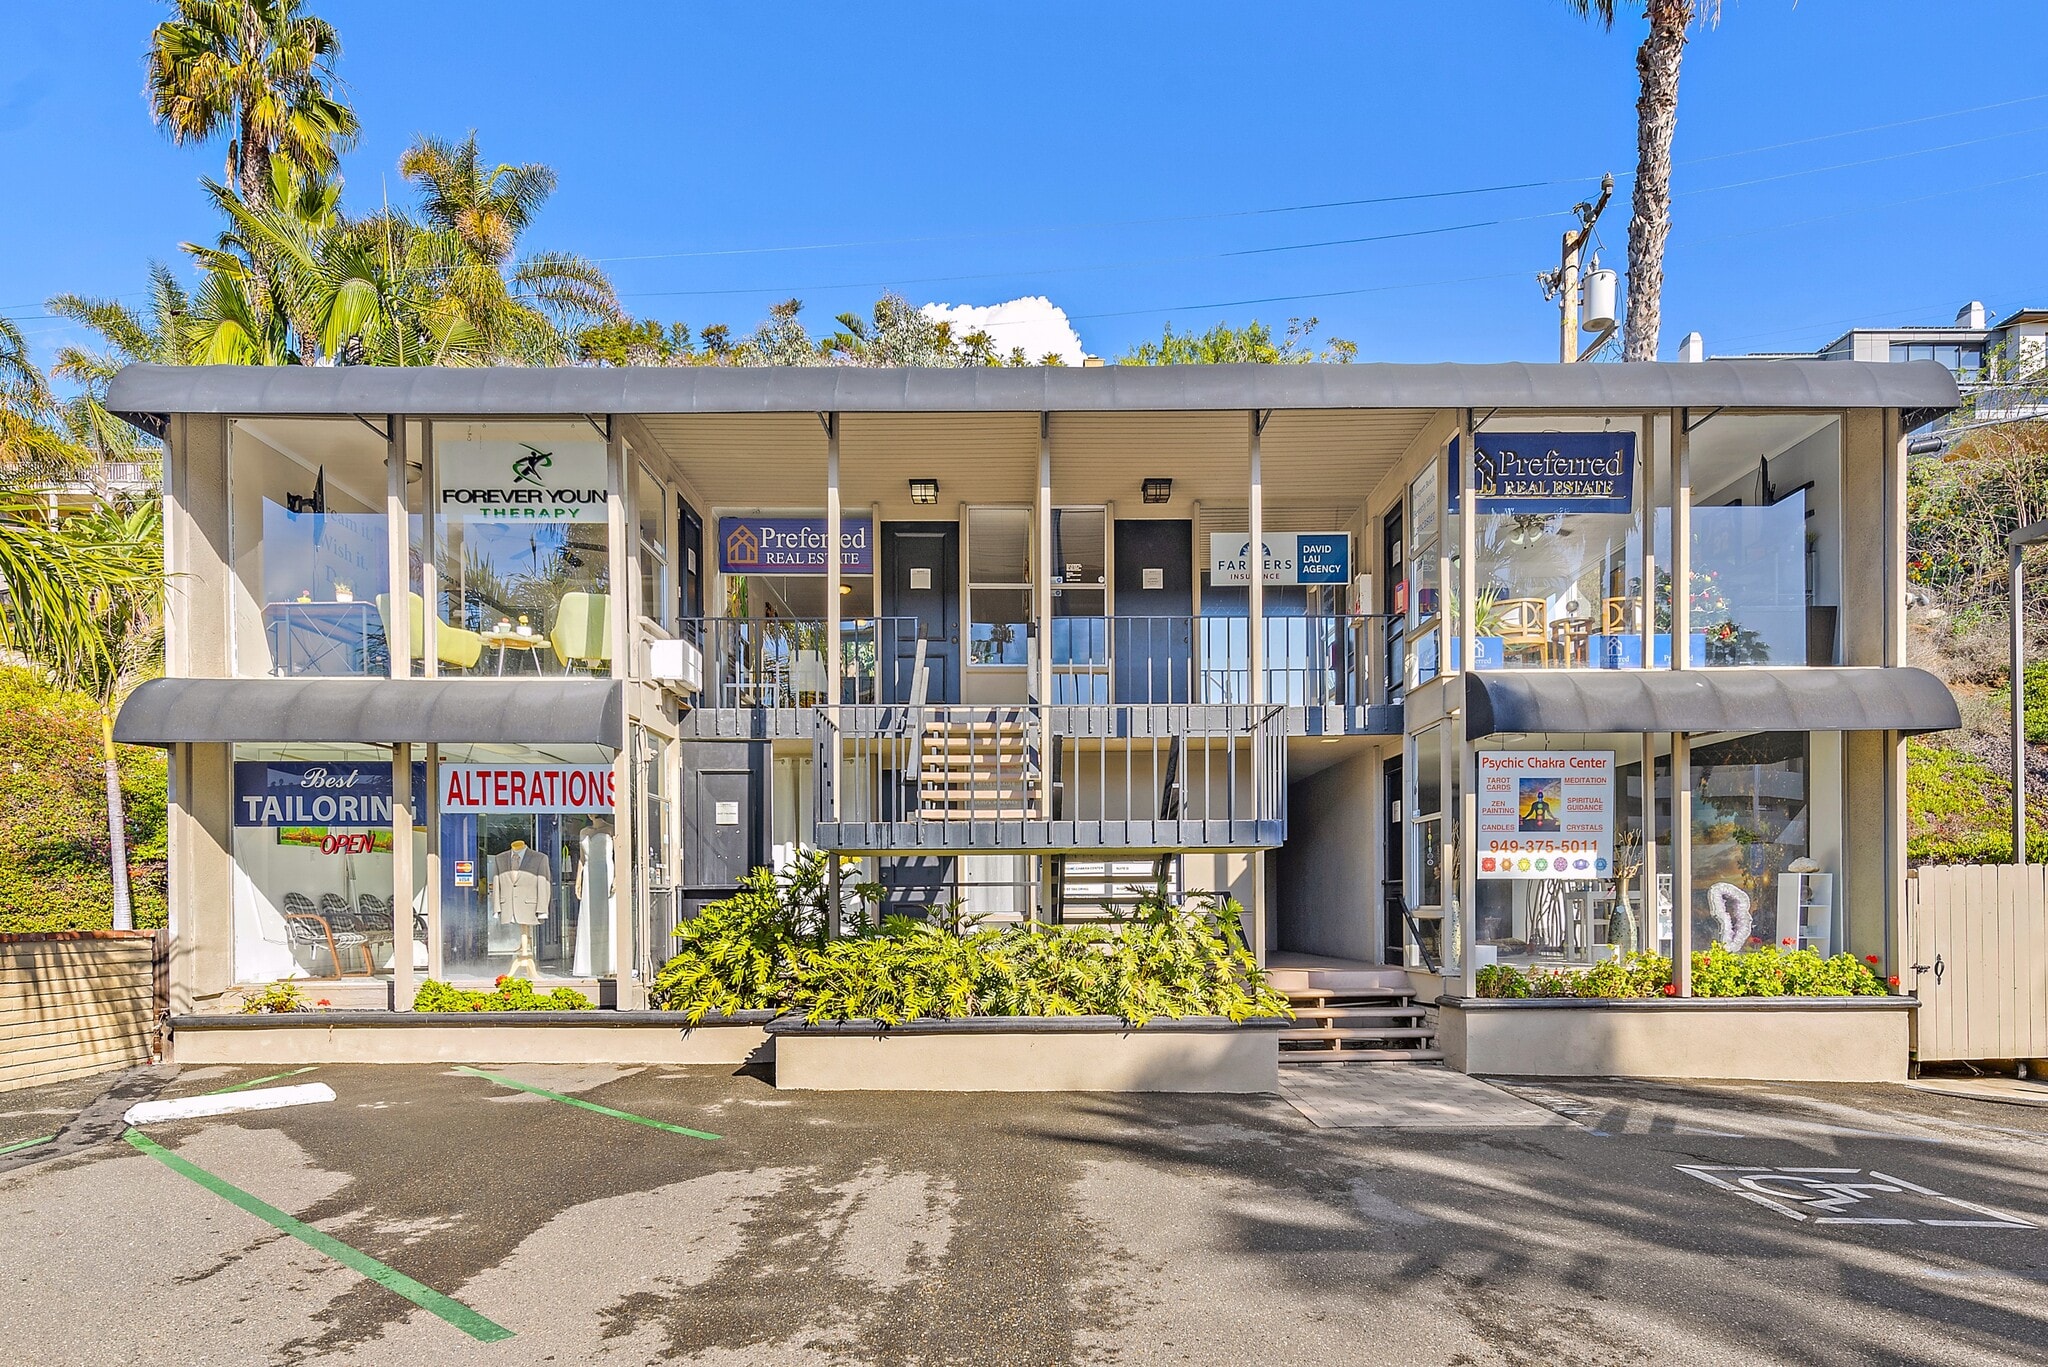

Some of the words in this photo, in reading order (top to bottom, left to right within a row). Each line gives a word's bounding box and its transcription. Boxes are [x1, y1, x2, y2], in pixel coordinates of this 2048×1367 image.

[1498, 449, 1624, 477] Preferred
[1503, 480, 1550, 496] REAL
[1552, 480, 1614, 495] ESTATE
[442, 489, 543, 504] FOREVER
[546, 489, 608, 504] YOUN
[326, 507, 359, 534] ream
[479, 508, 580, 518] THERAPY
[759, 526, 866, 549] Prefered
[1303, 545, 1332, 553] DAVID
[766, 552, 805, 565] REAL
[808, 552, 860, 565] ESTE
[1218, 559, 1292, 570] FARERS
[1303, 555, 1321, 563] LAU
[1302, 564, 1342, 574] AGENCY
[1482, 757, 1524, 771] Psychic
[1527, 757, 1565, 768] Chakra
[1569, 757, 1607, 768] Center
[300, 767, 360, 789] Best
[446, 770, 616, 807] ALTERATIONS
[242, 795, 417, 822] TAILORIN
[320, 833, 376, 855] OPEN
[1489, 840, 1598, 853] 949-375-5011
